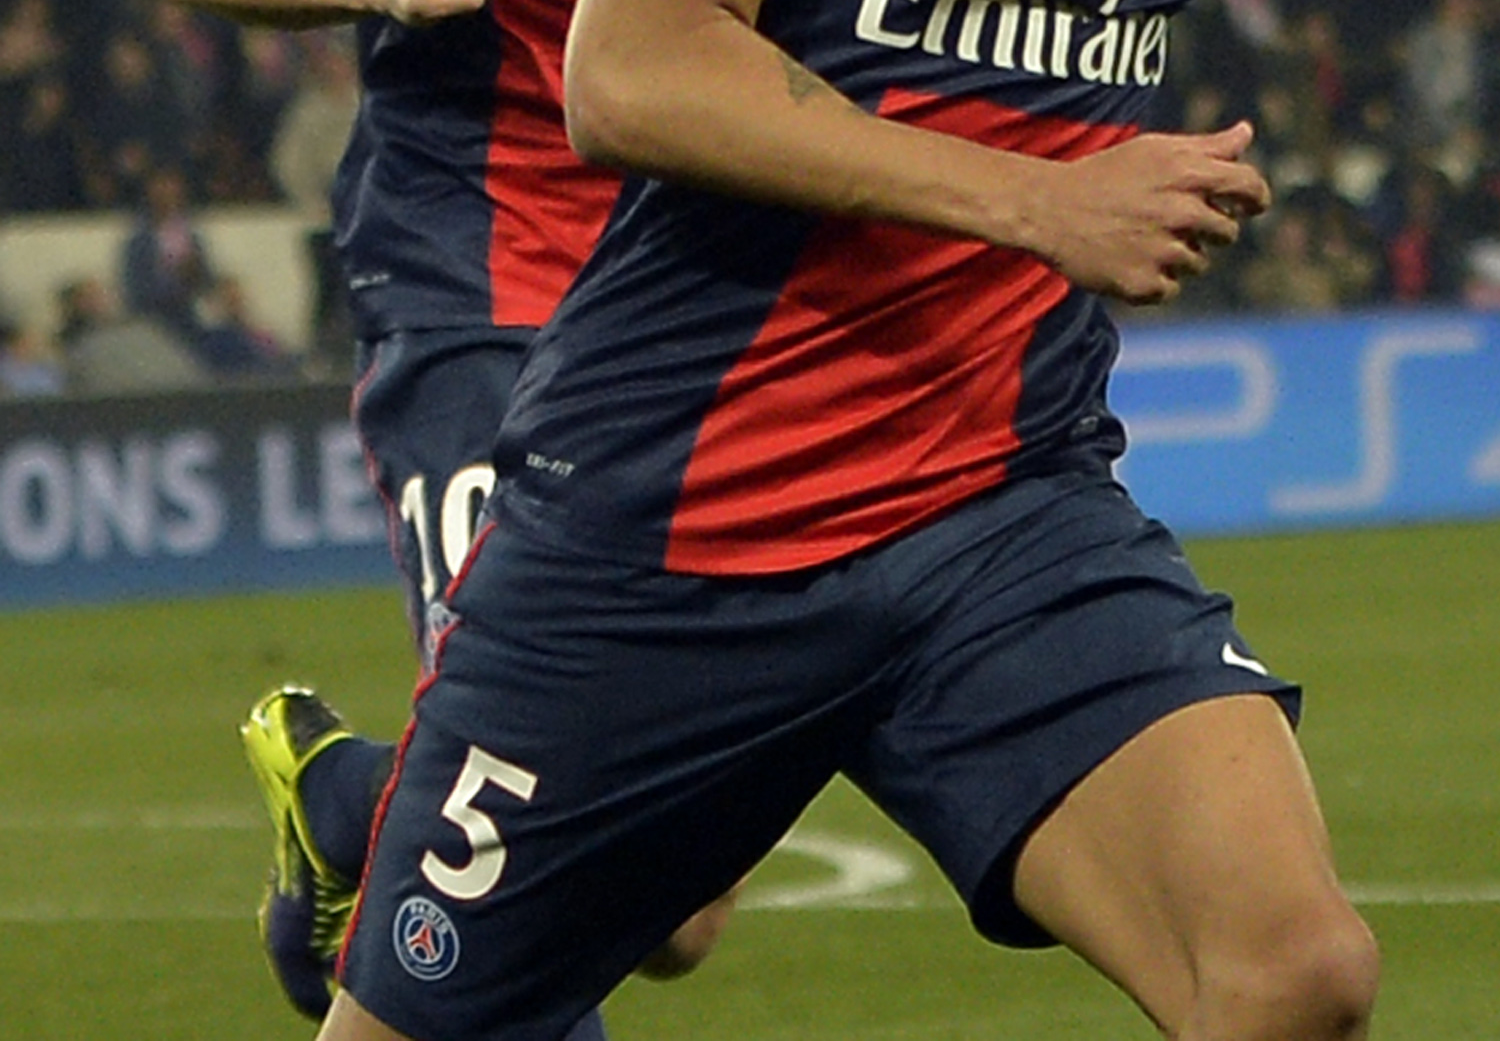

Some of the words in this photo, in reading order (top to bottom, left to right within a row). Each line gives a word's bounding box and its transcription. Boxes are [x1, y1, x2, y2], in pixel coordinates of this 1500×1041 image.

[0, 431, 224, 561] ONS
[401, 463, 496, 604] 10
[421, 744, 539, 900] 5
